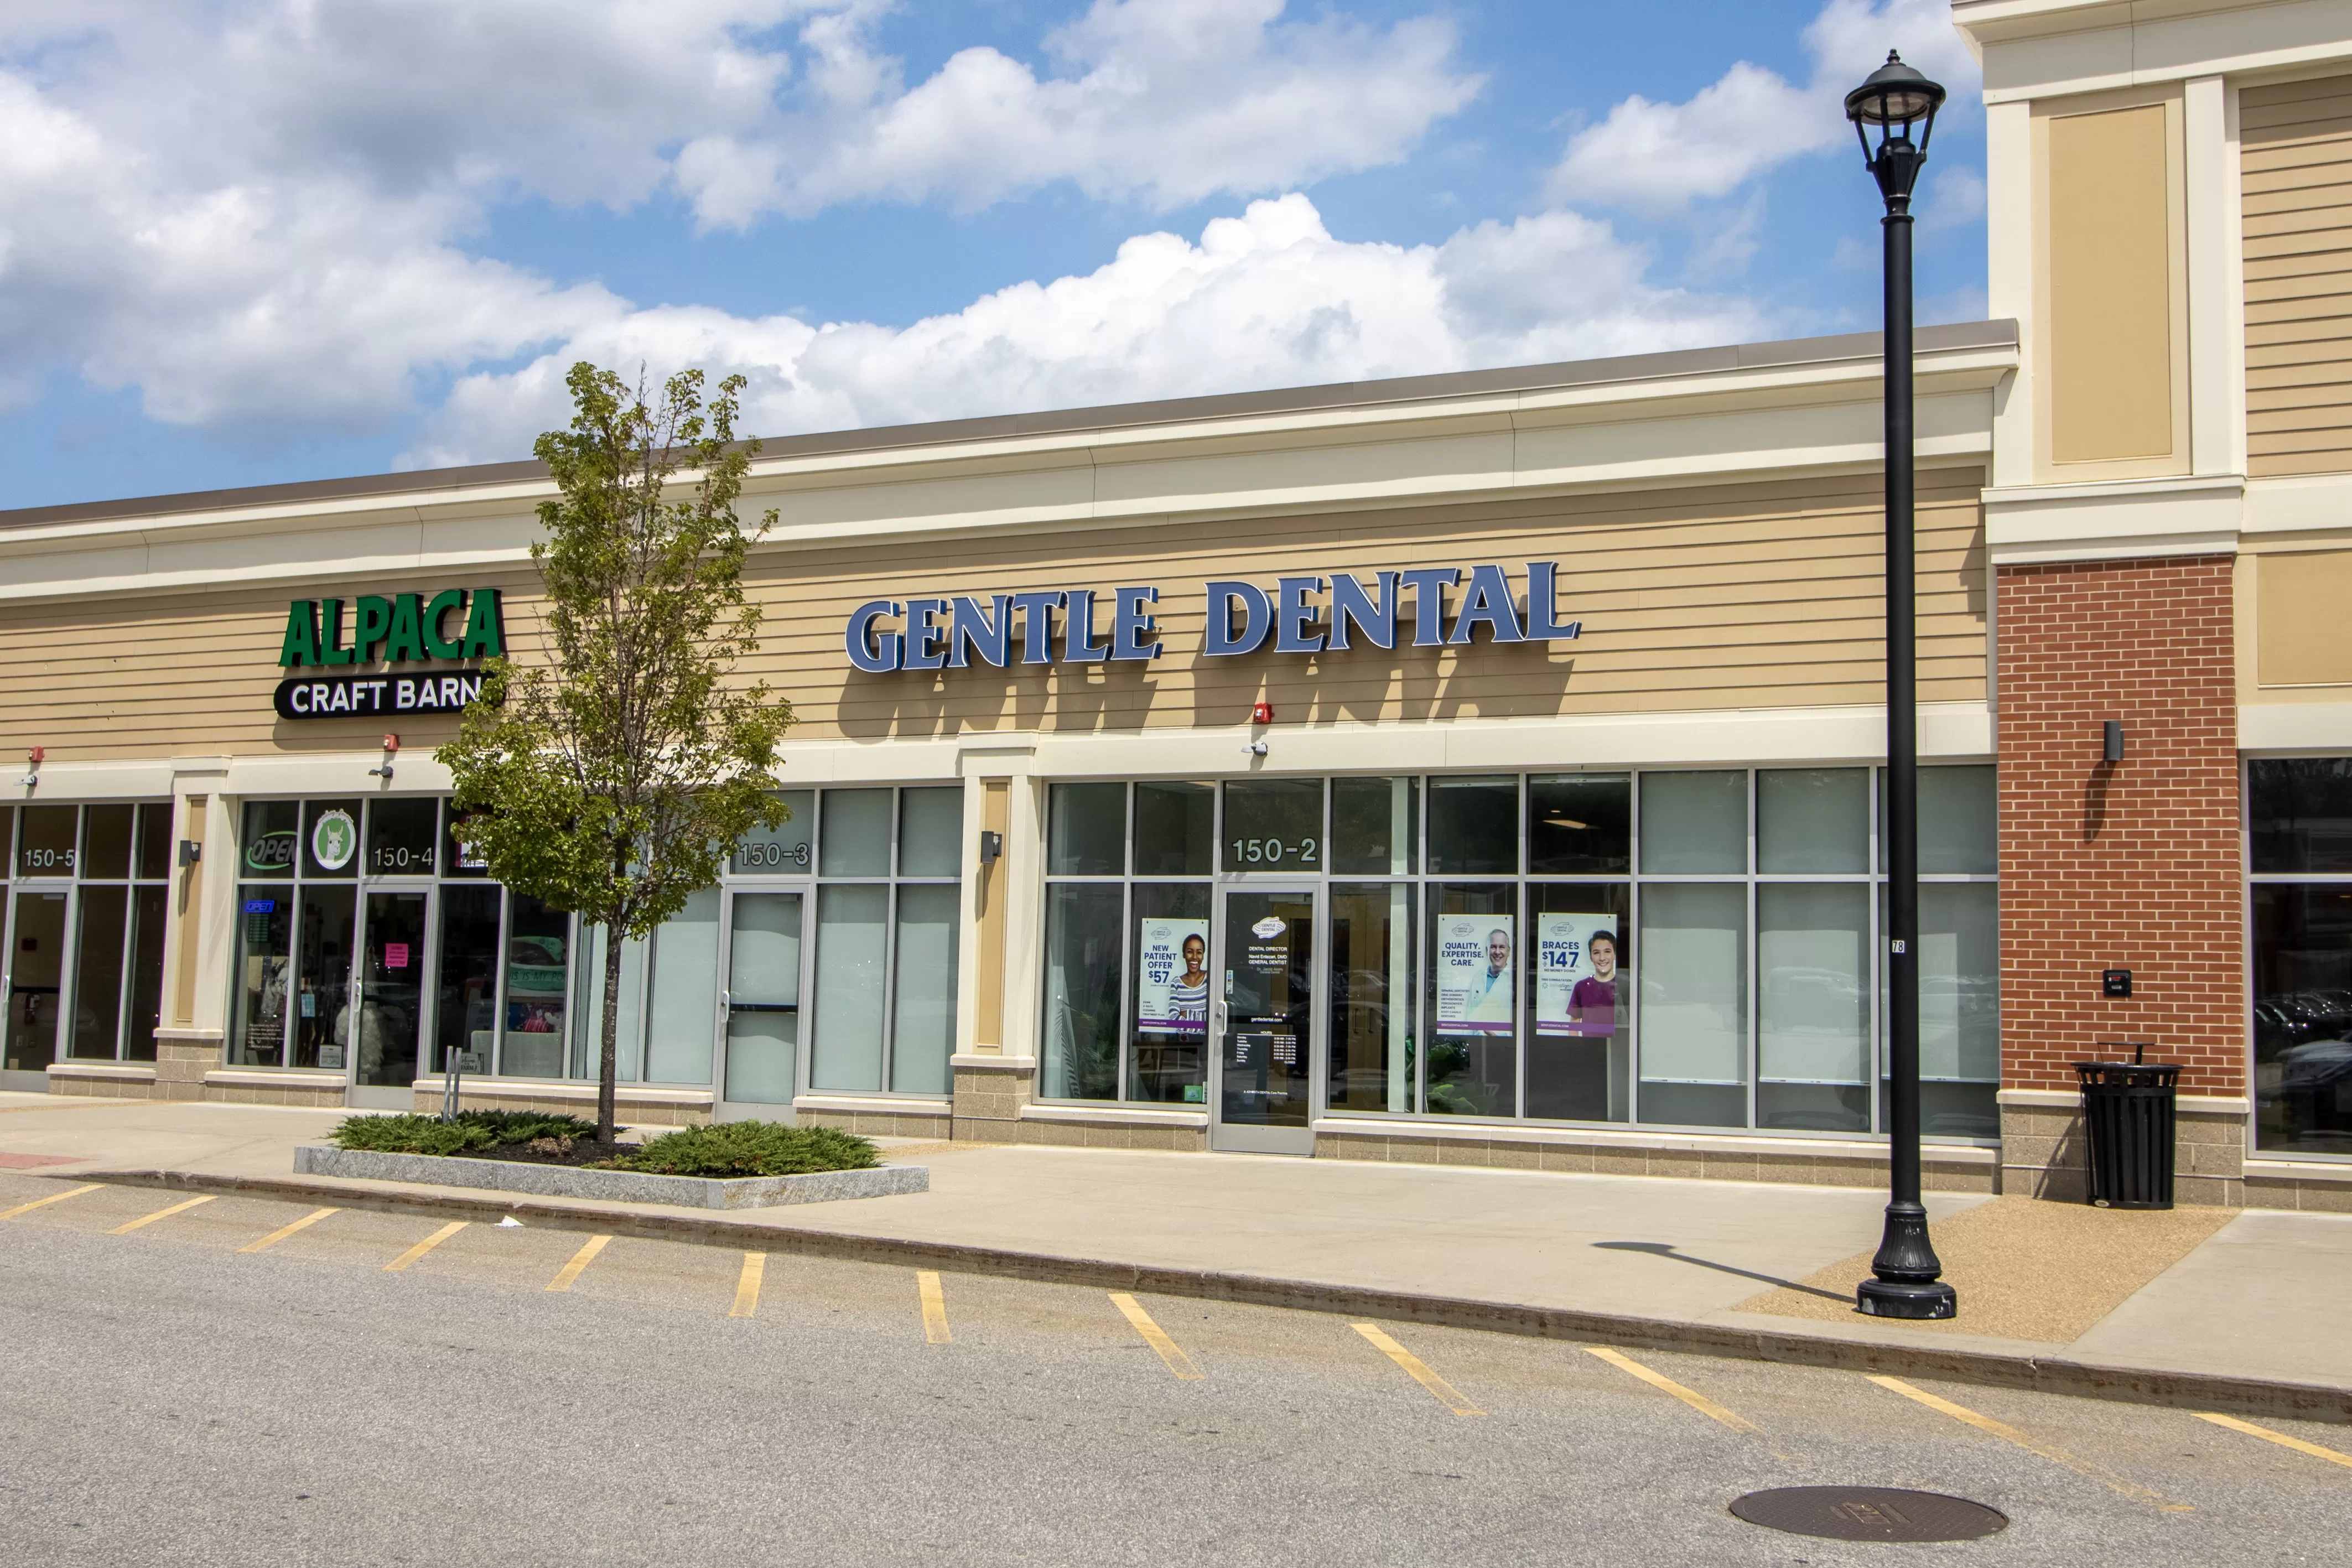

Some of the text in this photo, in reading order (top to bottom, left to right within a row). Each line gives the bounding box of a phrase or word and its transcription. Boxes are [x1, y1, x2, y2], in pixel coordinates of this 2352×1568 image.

[845, 561, 1582, 673] GENTLE DENTAL
[278, 589, 505, 667] ALPACA
[290, 677, 481, 713] CRAFT BARN
[25, 848, 75, 867] 150-5
[375, 847, 434, 866] 150-4
[739, 842, 809, 866] 150-3
[1232, 837, 1317, 863] 150-2
[1542, 941, 1580, 949] BRACES
[1893, 941, 1904, 952] 78
[1144, 952, 1177, 960] PATIENT
[1542, 951, 1579, 968] $147
[1149, 970, 1170, 984] $57
